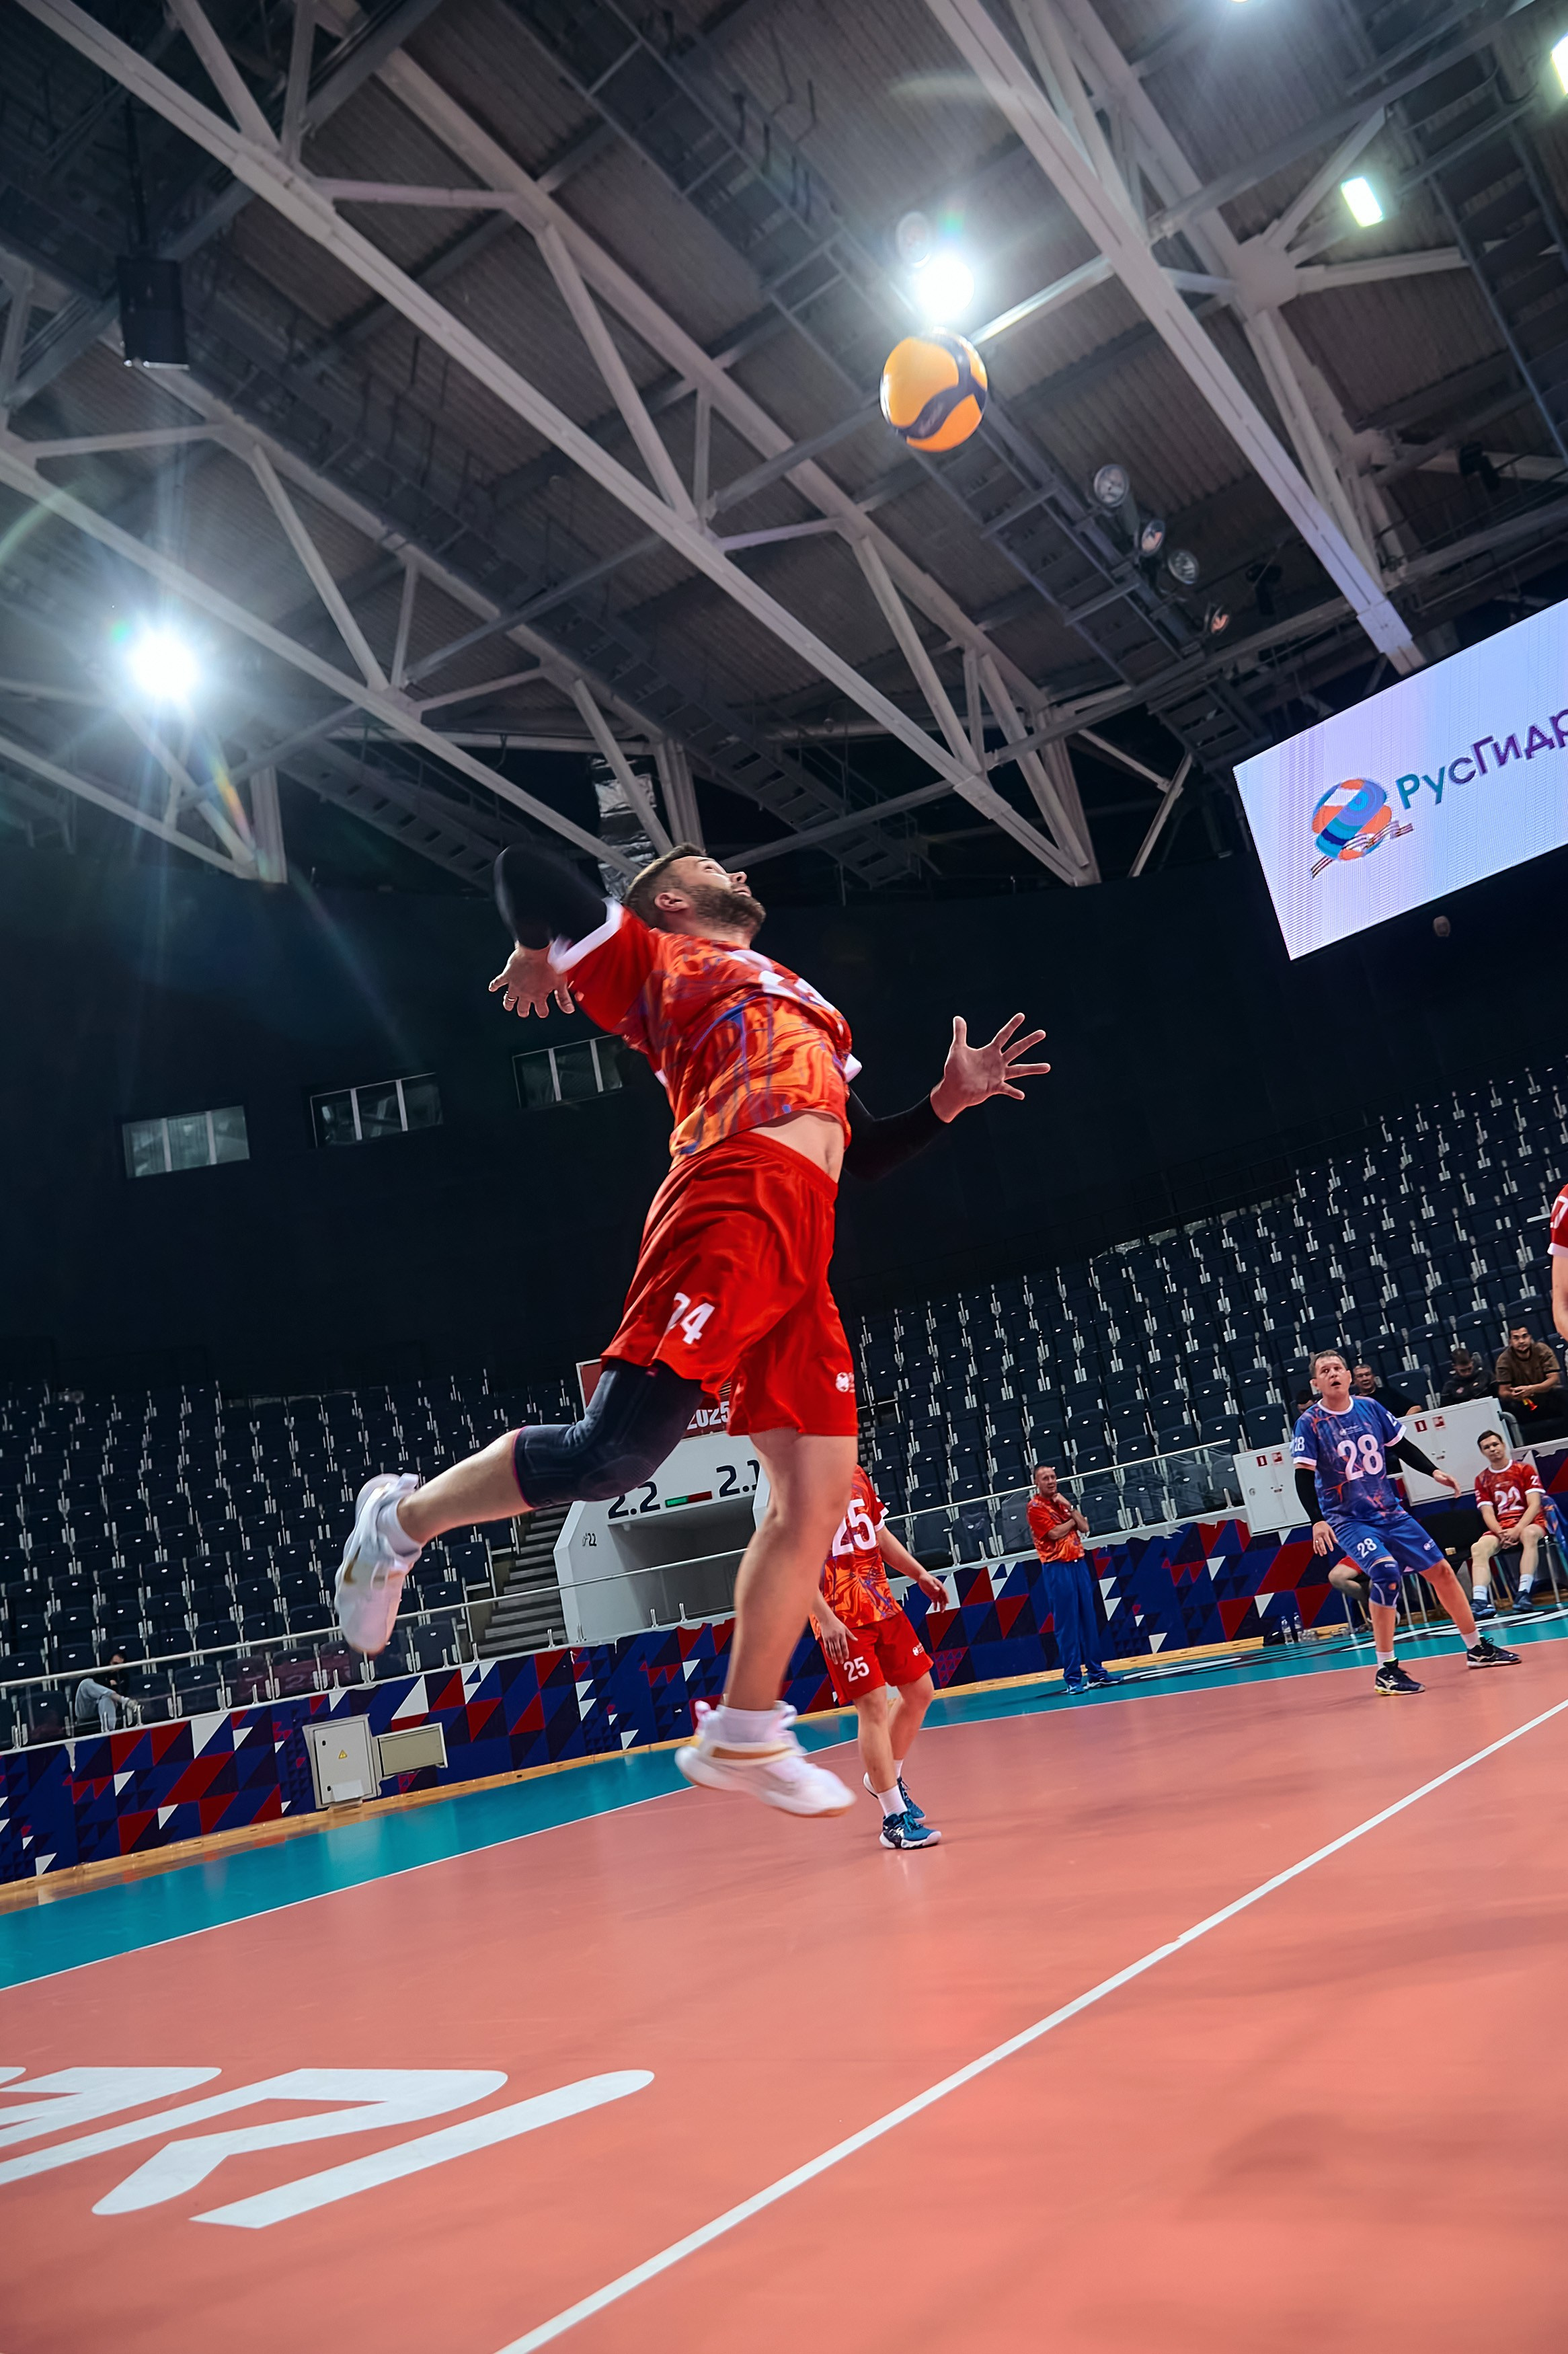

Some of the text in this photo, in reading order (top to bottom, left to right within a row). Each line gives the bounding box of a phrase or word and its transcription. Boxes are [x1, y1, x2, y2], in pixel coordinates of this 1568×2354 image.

[1395, 708, 1568, 810] РусГидр
[1337, 1434, 1383, 1480] 28
[608, 1481, 661, 1519] 2.2
[1493, 1486, 1525, 1515] 22
[832, 1498, 877, 1557] 25
[1357, 1537, 1377, 1558] 28
[843, 1656, 870, 1682] 25
